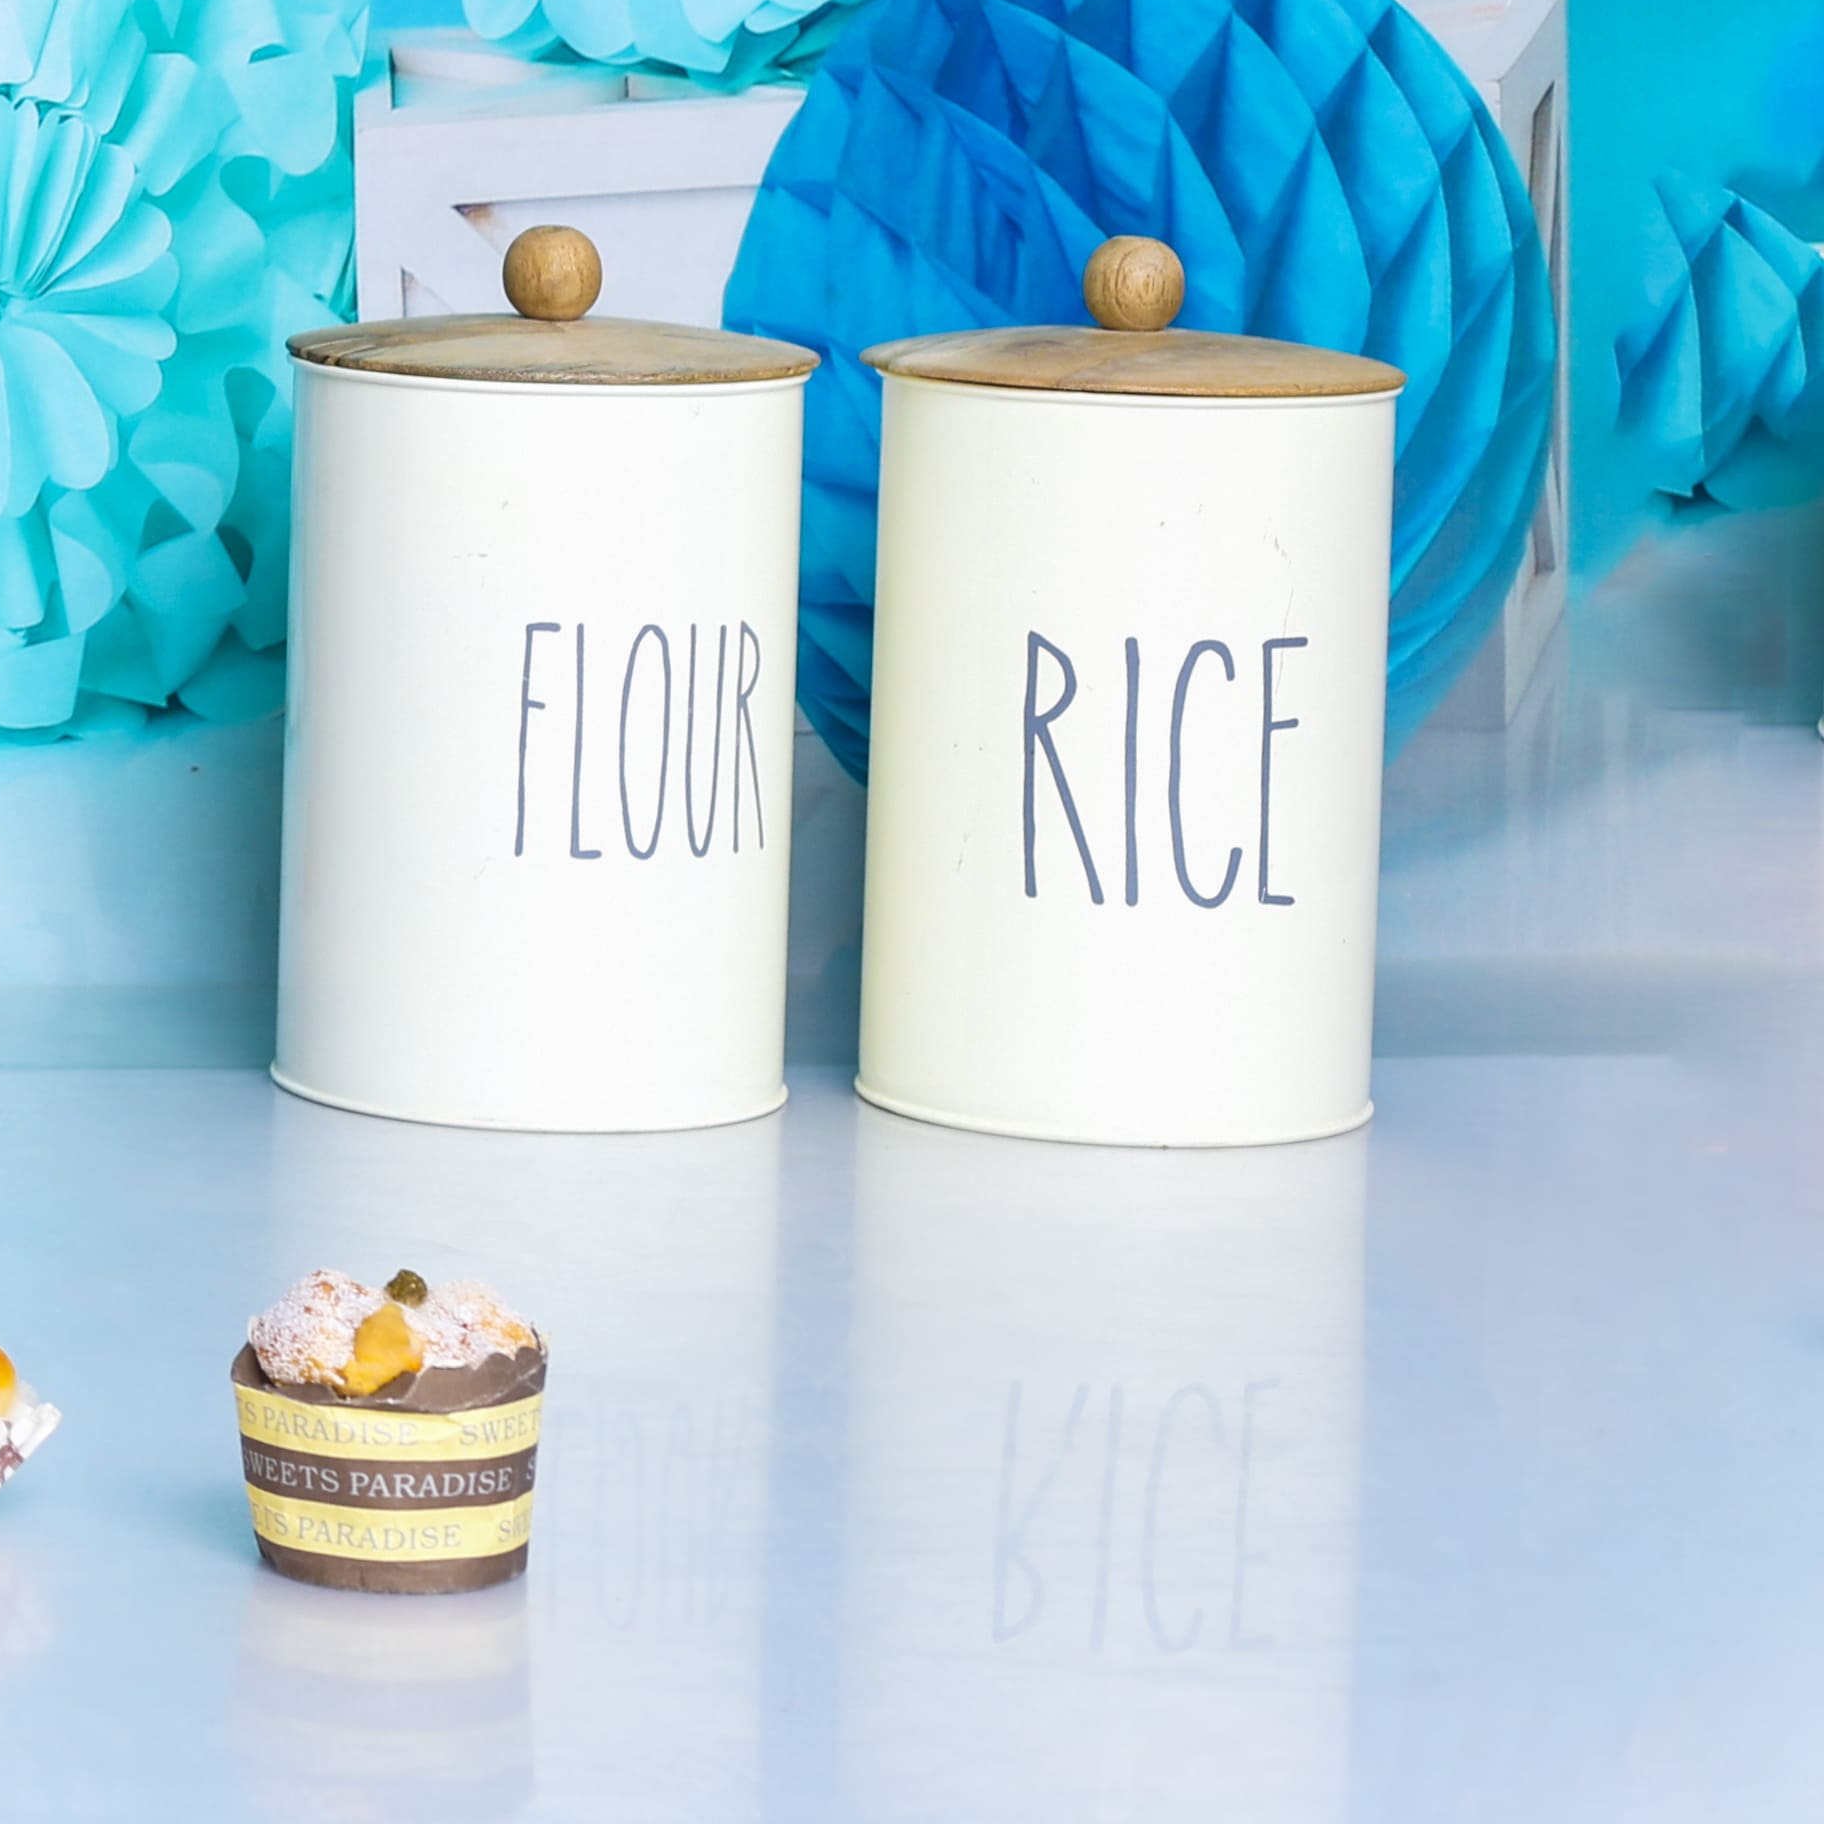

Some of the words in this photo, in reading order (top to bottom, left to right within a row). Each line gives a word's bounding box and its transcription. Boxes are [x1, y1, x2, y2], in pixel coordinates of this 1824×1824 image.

[513, 619, 765, 861] FLOUR
[1022, 630, 1309, 908] RICE
[263, 1405, 420, 1447] PARADISE
[243, 1448, 341, 1494] SWEETS
[348, 1466, 513, 1500] PARADISE
[297, 1514, 463, 1552] PARADISE
